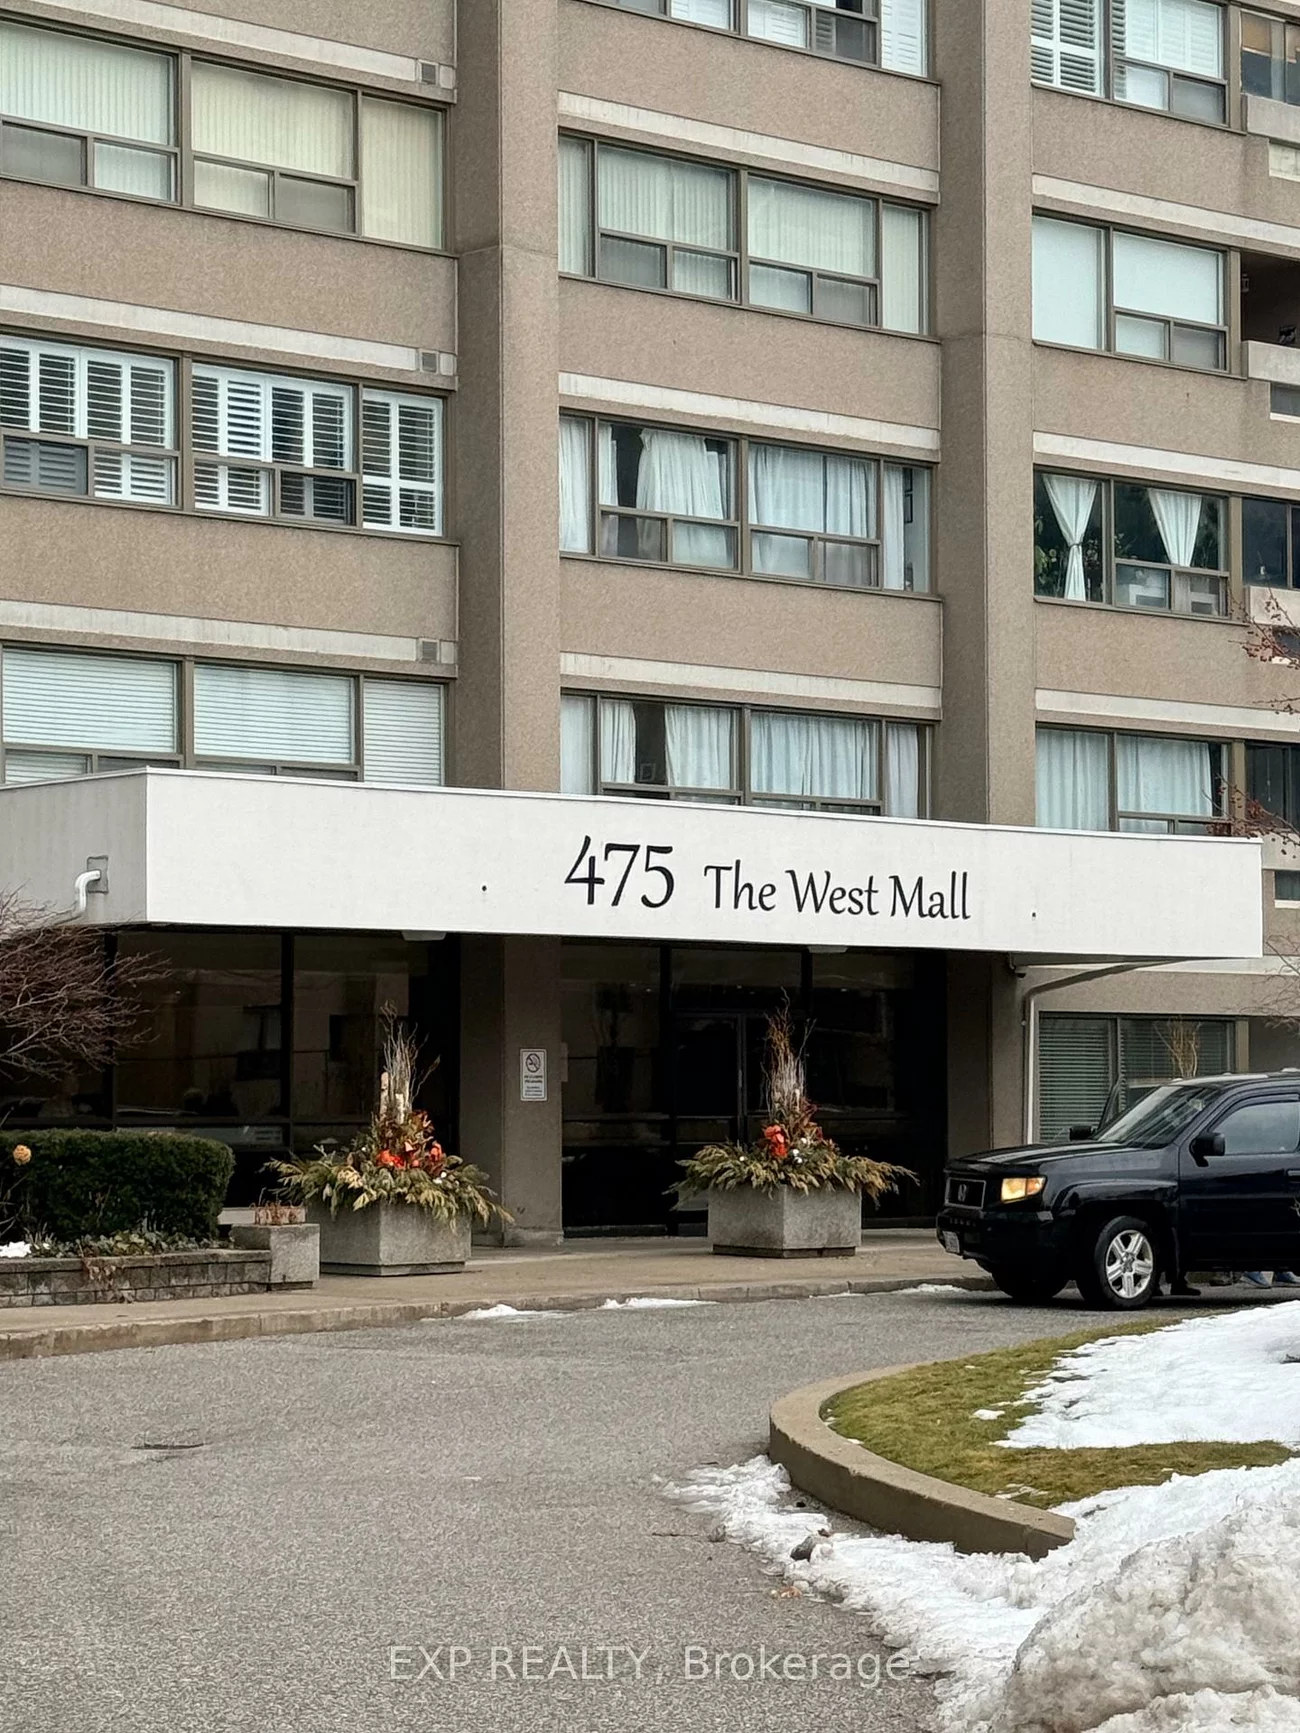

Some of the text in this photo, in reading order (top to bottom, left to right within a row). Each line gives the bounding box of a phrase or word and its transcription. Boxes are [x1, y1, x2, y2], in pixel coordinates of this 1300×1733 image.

[564, 835, 971, 920] 475 The West Mall
